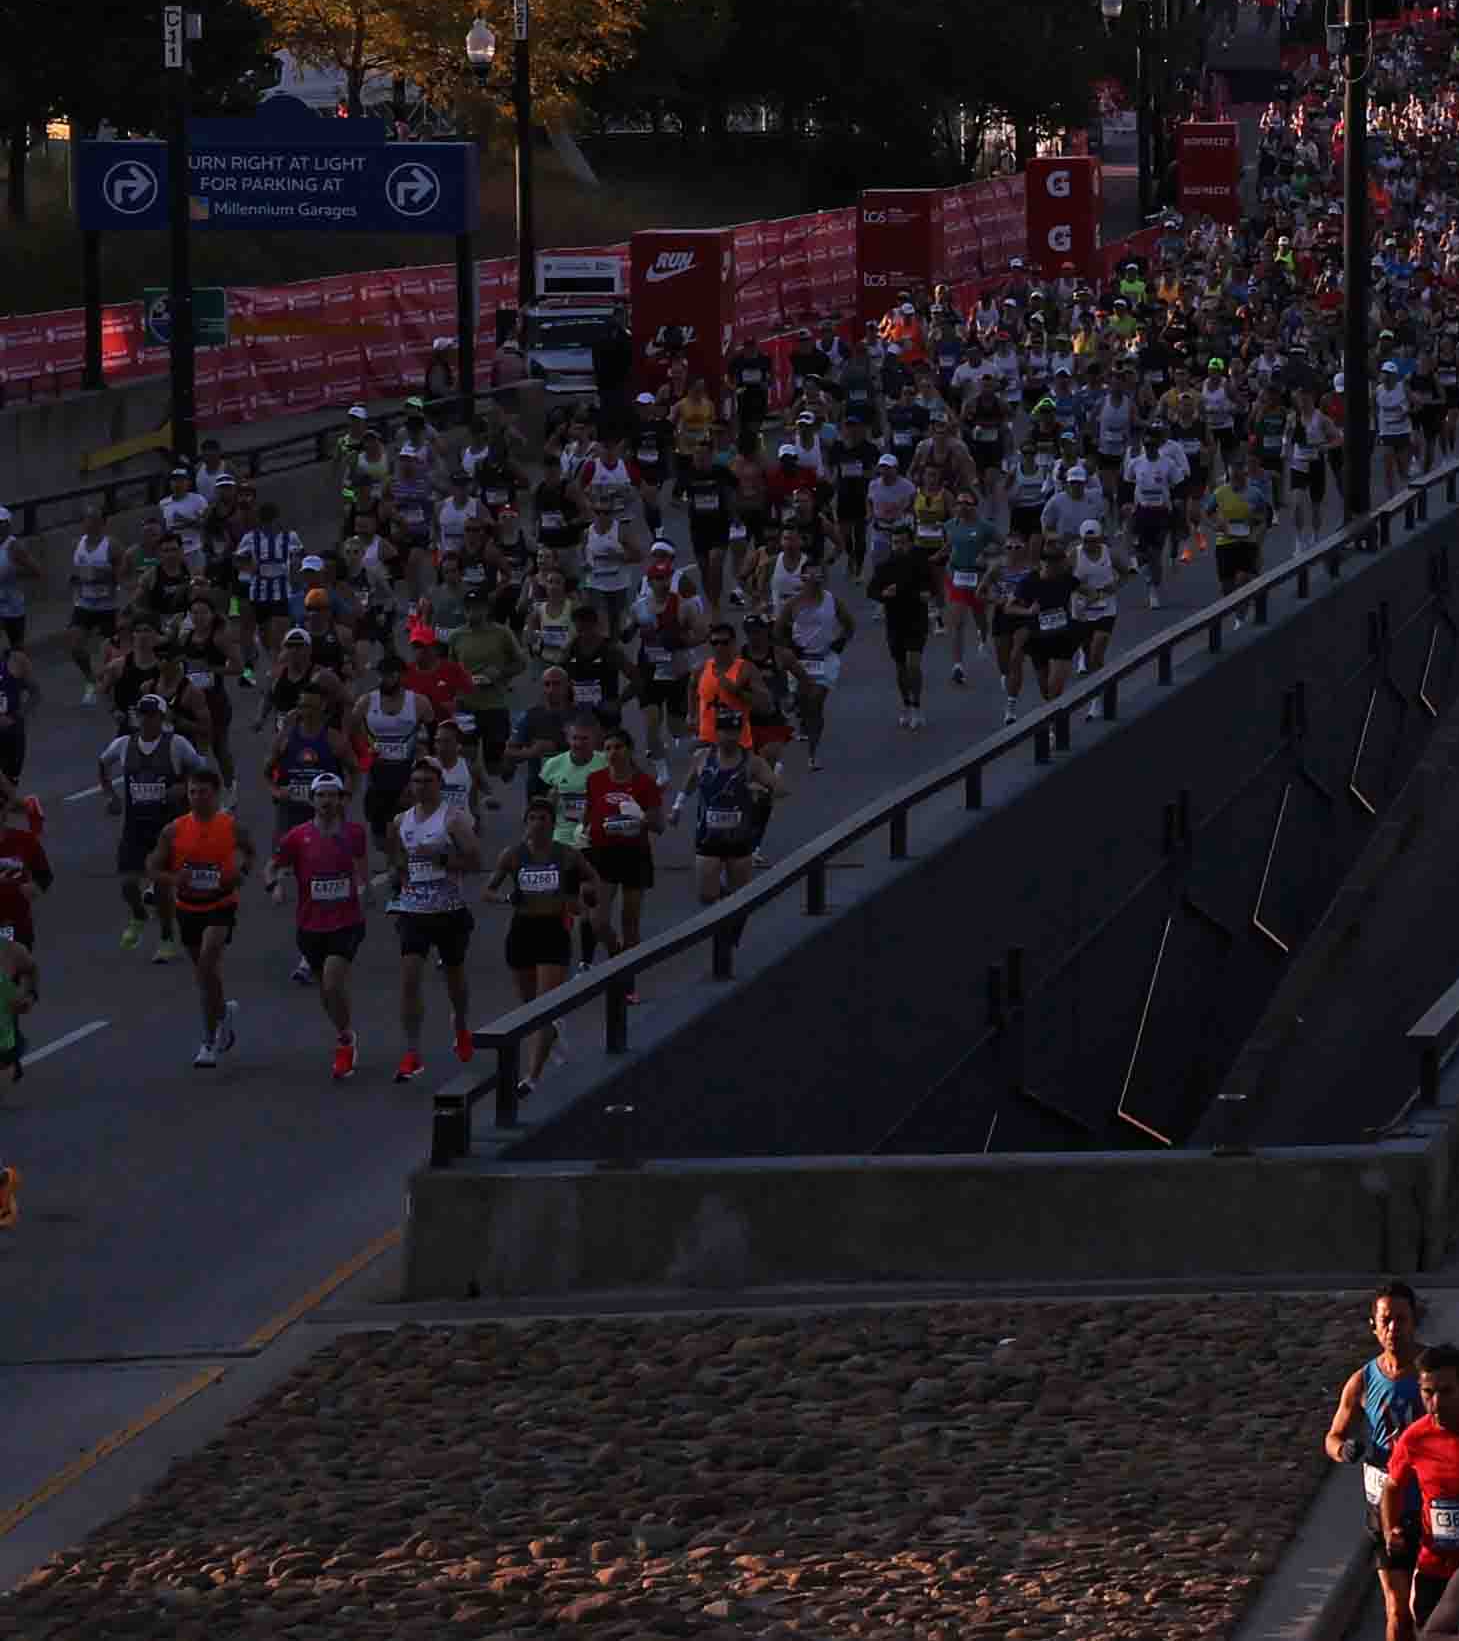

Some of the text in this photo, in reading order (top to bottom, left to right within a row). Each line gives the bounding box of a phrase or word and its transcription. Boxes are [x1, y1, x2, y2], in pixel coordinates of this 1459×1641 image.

[166, 9, 179, 64] C11
[188, 155, 368, 172] URN RIGHT AT LIGHT
[199, 176, 345, 192] FOR PARKING AT
[1046, 169, 1072, 198] G
[214, 201, 358, 220] Millennium Garages
[1047, 223, 1073, 253] G
[655, 251, 695, 270] RUN
